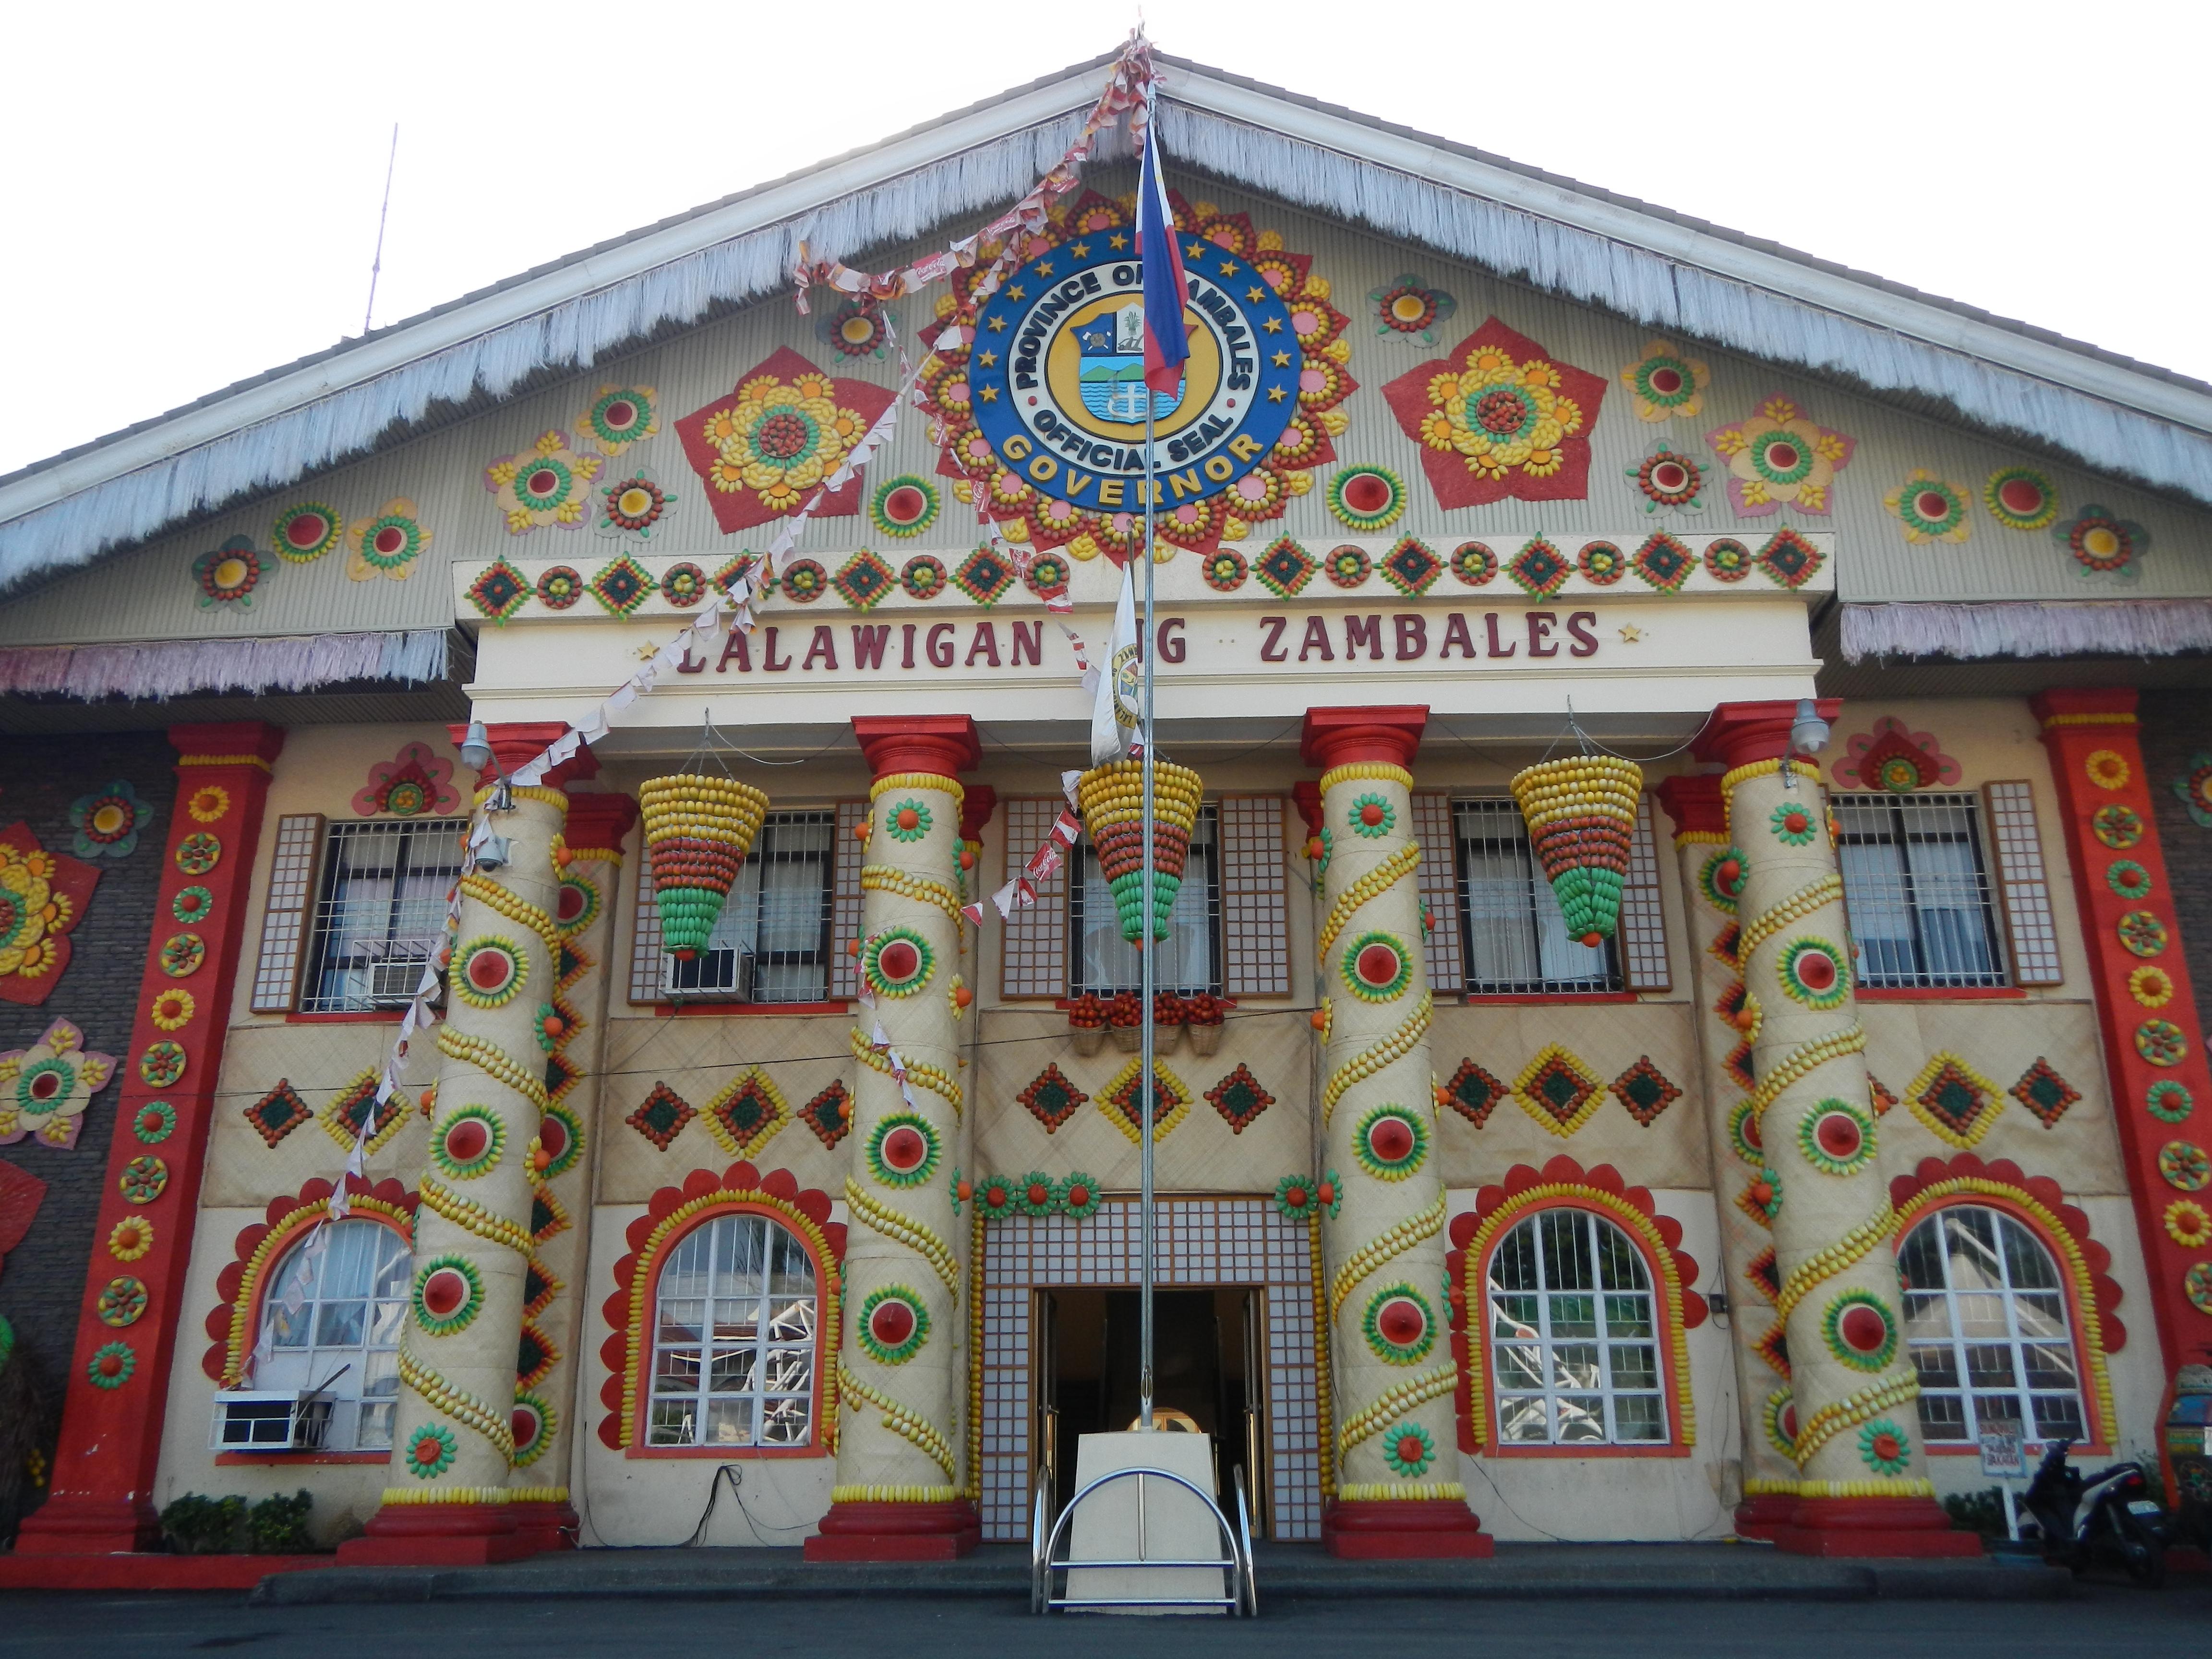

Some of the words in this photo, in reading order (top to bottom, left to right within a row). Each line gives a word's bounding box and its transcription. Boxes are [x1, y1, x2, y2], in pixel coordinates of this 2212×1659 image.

[1014, 271, 1102, 390] PROVINCE
[1187, 278, 1253, 391] AMBALES
[1002, 433, 1264, 505] GOVERNOR
[1167, 414, 1234, 462] SEAL
[676, 620, 1043, 673] LALAWIGAN
[1260, 611, 1599, 662] ZAMBALES
